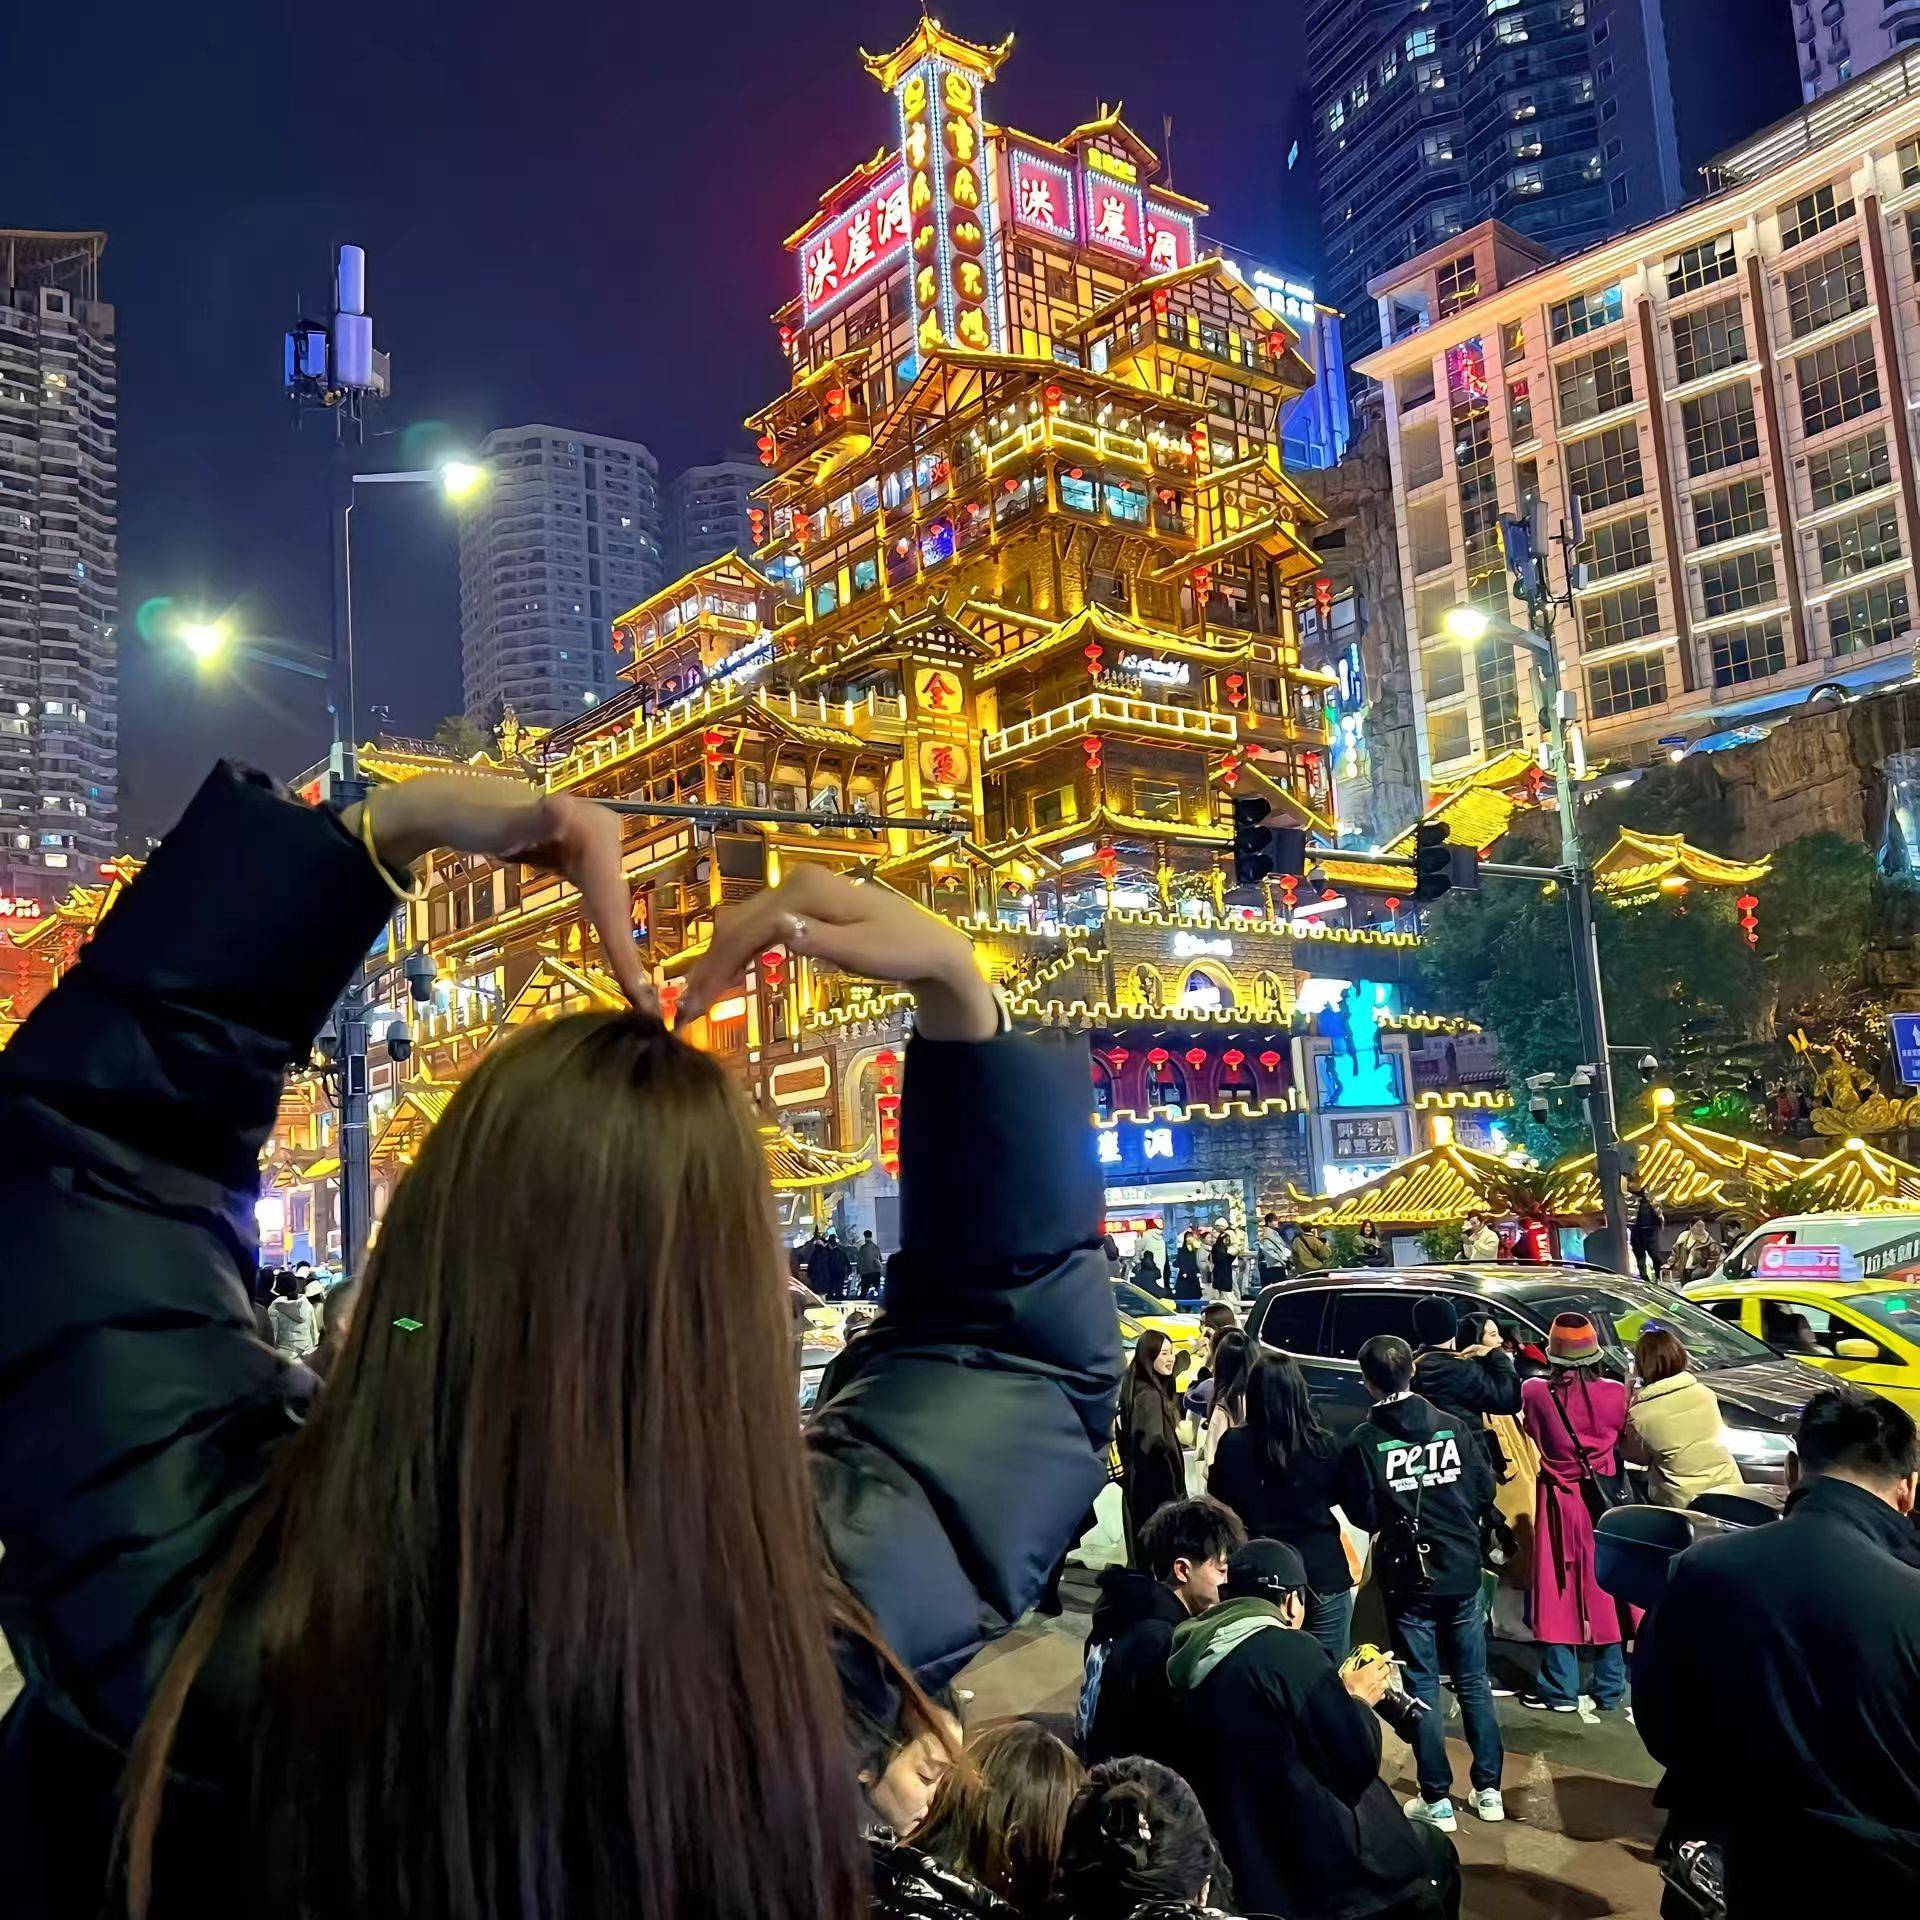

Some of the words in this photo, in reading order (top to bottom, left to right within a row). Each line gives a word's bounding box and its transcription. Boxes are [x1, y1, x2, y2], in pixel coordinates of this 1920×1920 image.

[808, 183, 911, 303] 洪崖洞
[1020, 177, 1179, 273] 洪崖洞
